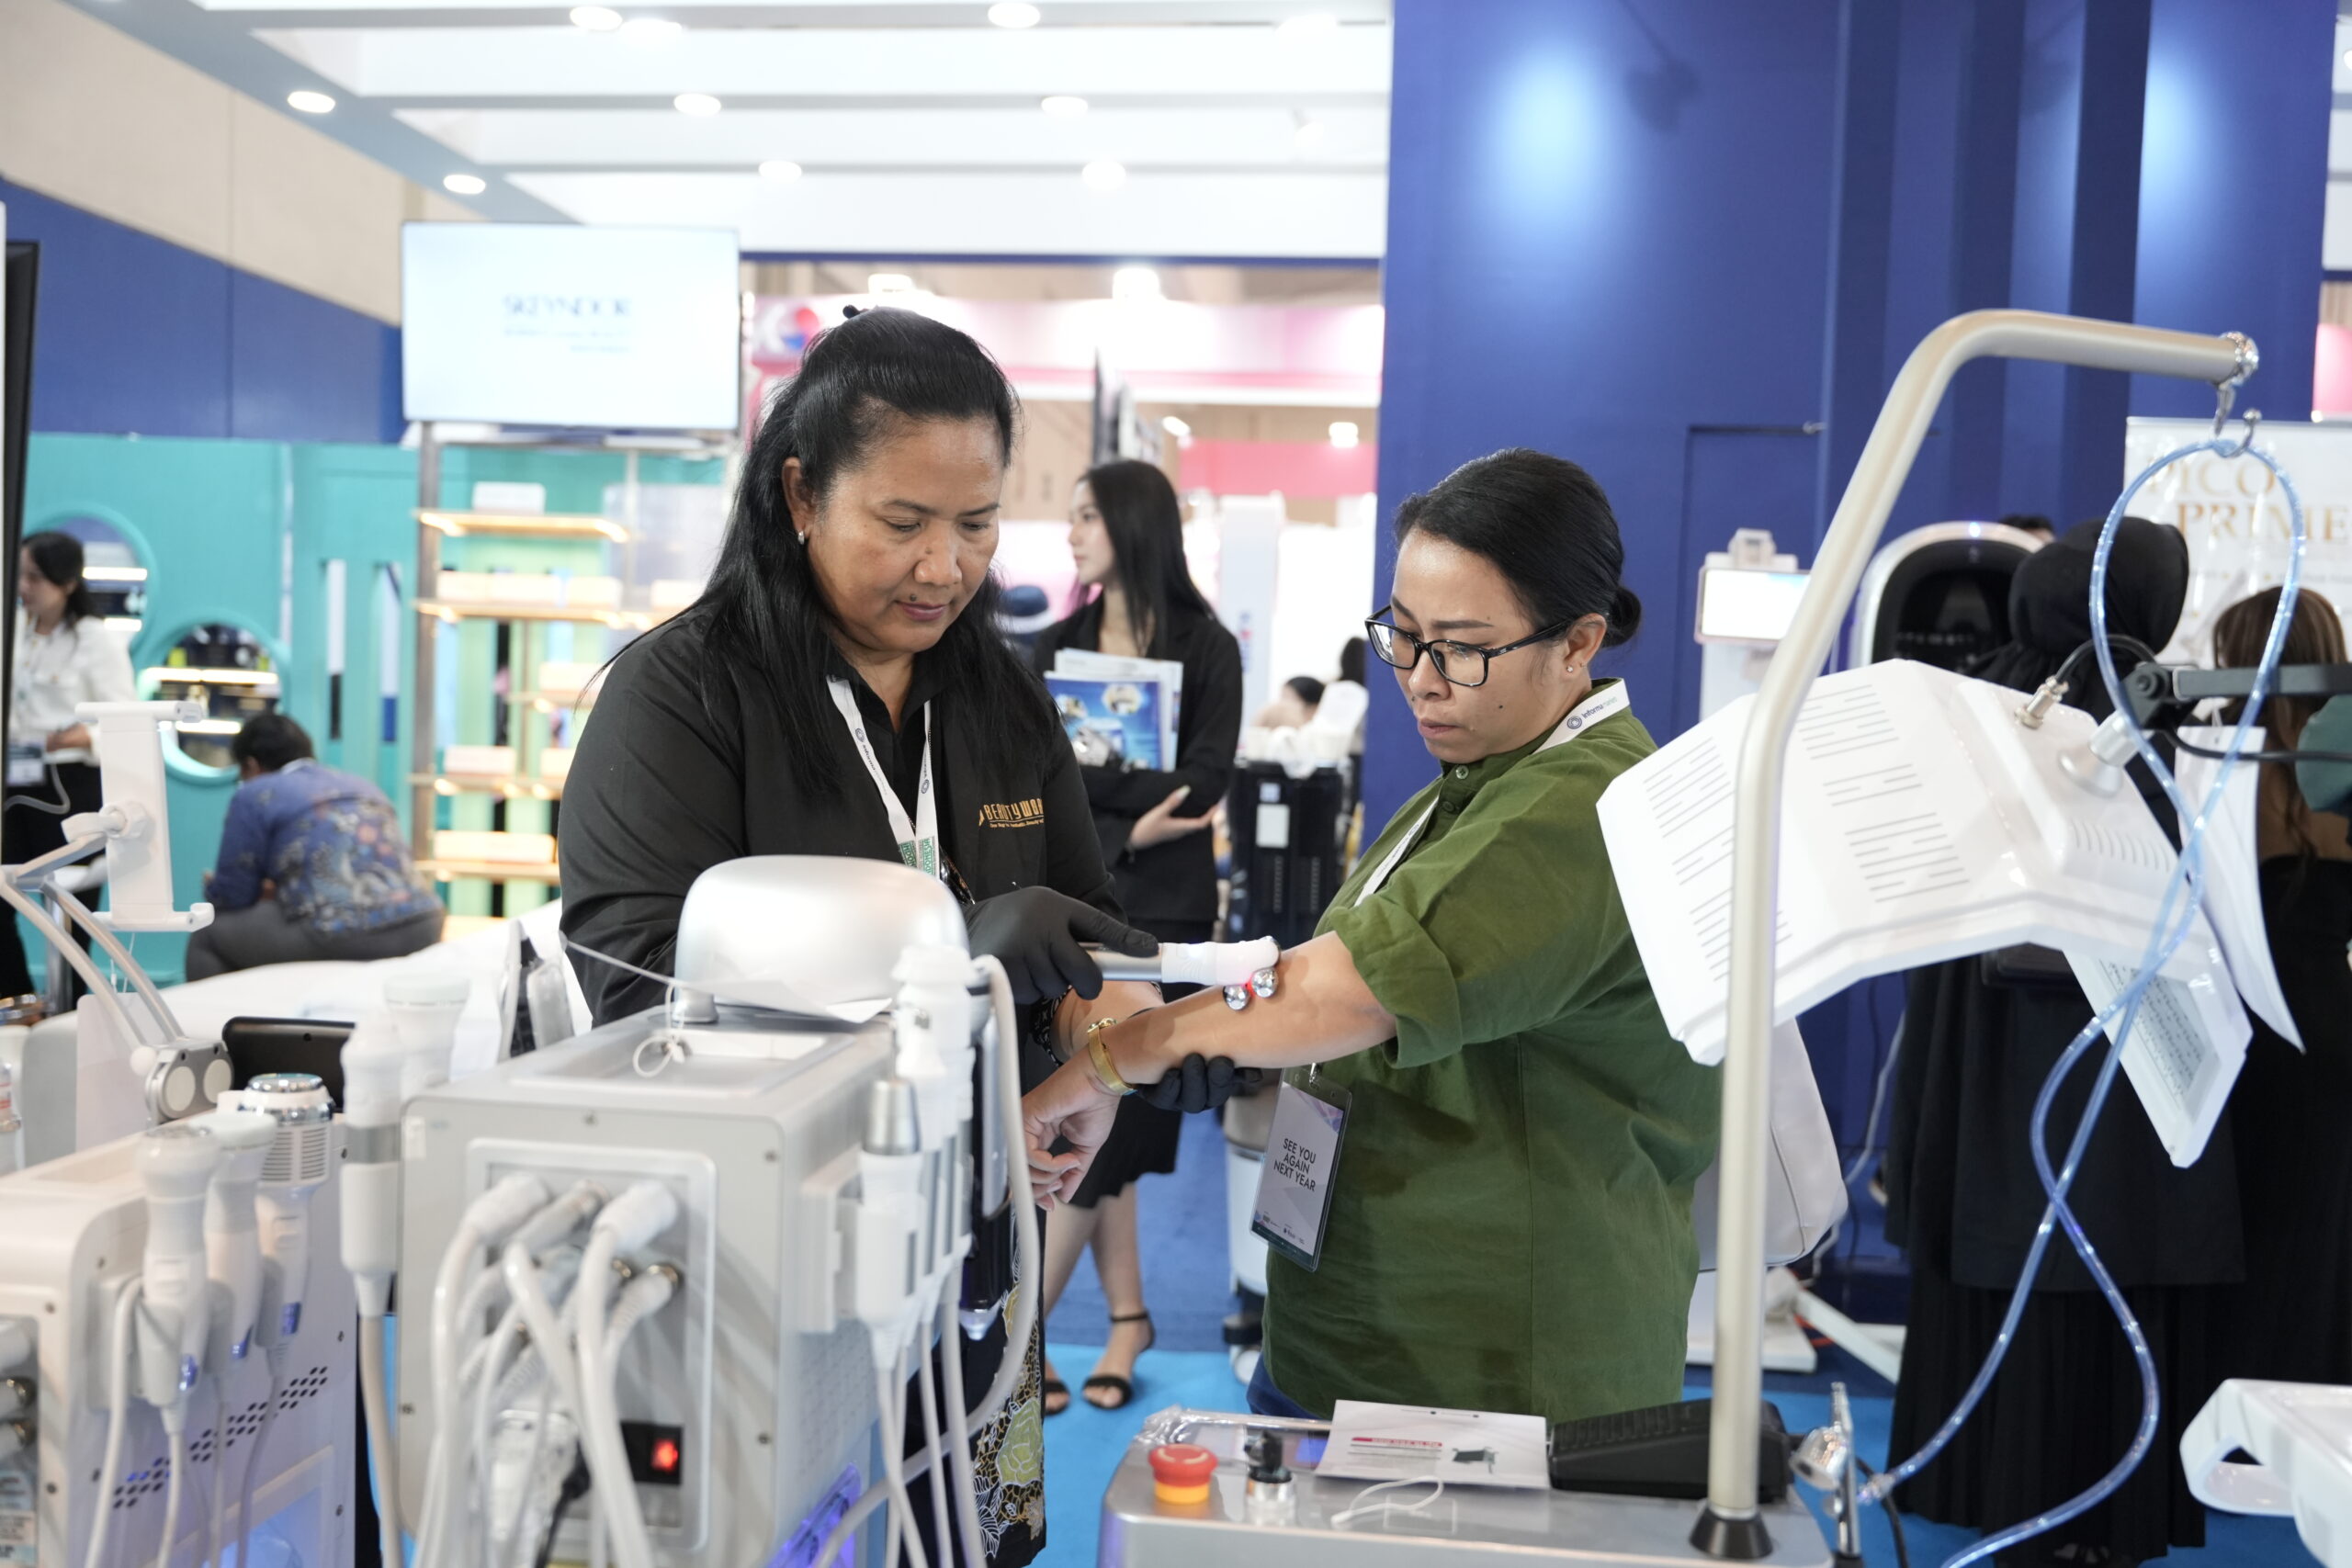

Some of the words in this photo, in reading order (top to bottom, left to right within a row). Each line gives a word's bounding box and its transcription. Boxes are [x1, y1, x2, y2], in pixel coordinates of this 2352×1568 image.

[1283, 1138, 1297, 1155] SEE
[1299, 1145, 1316, 1164] YOU
[1283, 1152, 1310, 1174] AGAIN
[1273, 1158, 1295, 1179] NEXT
[1295, 1170, 1316, 1191] YEAR
